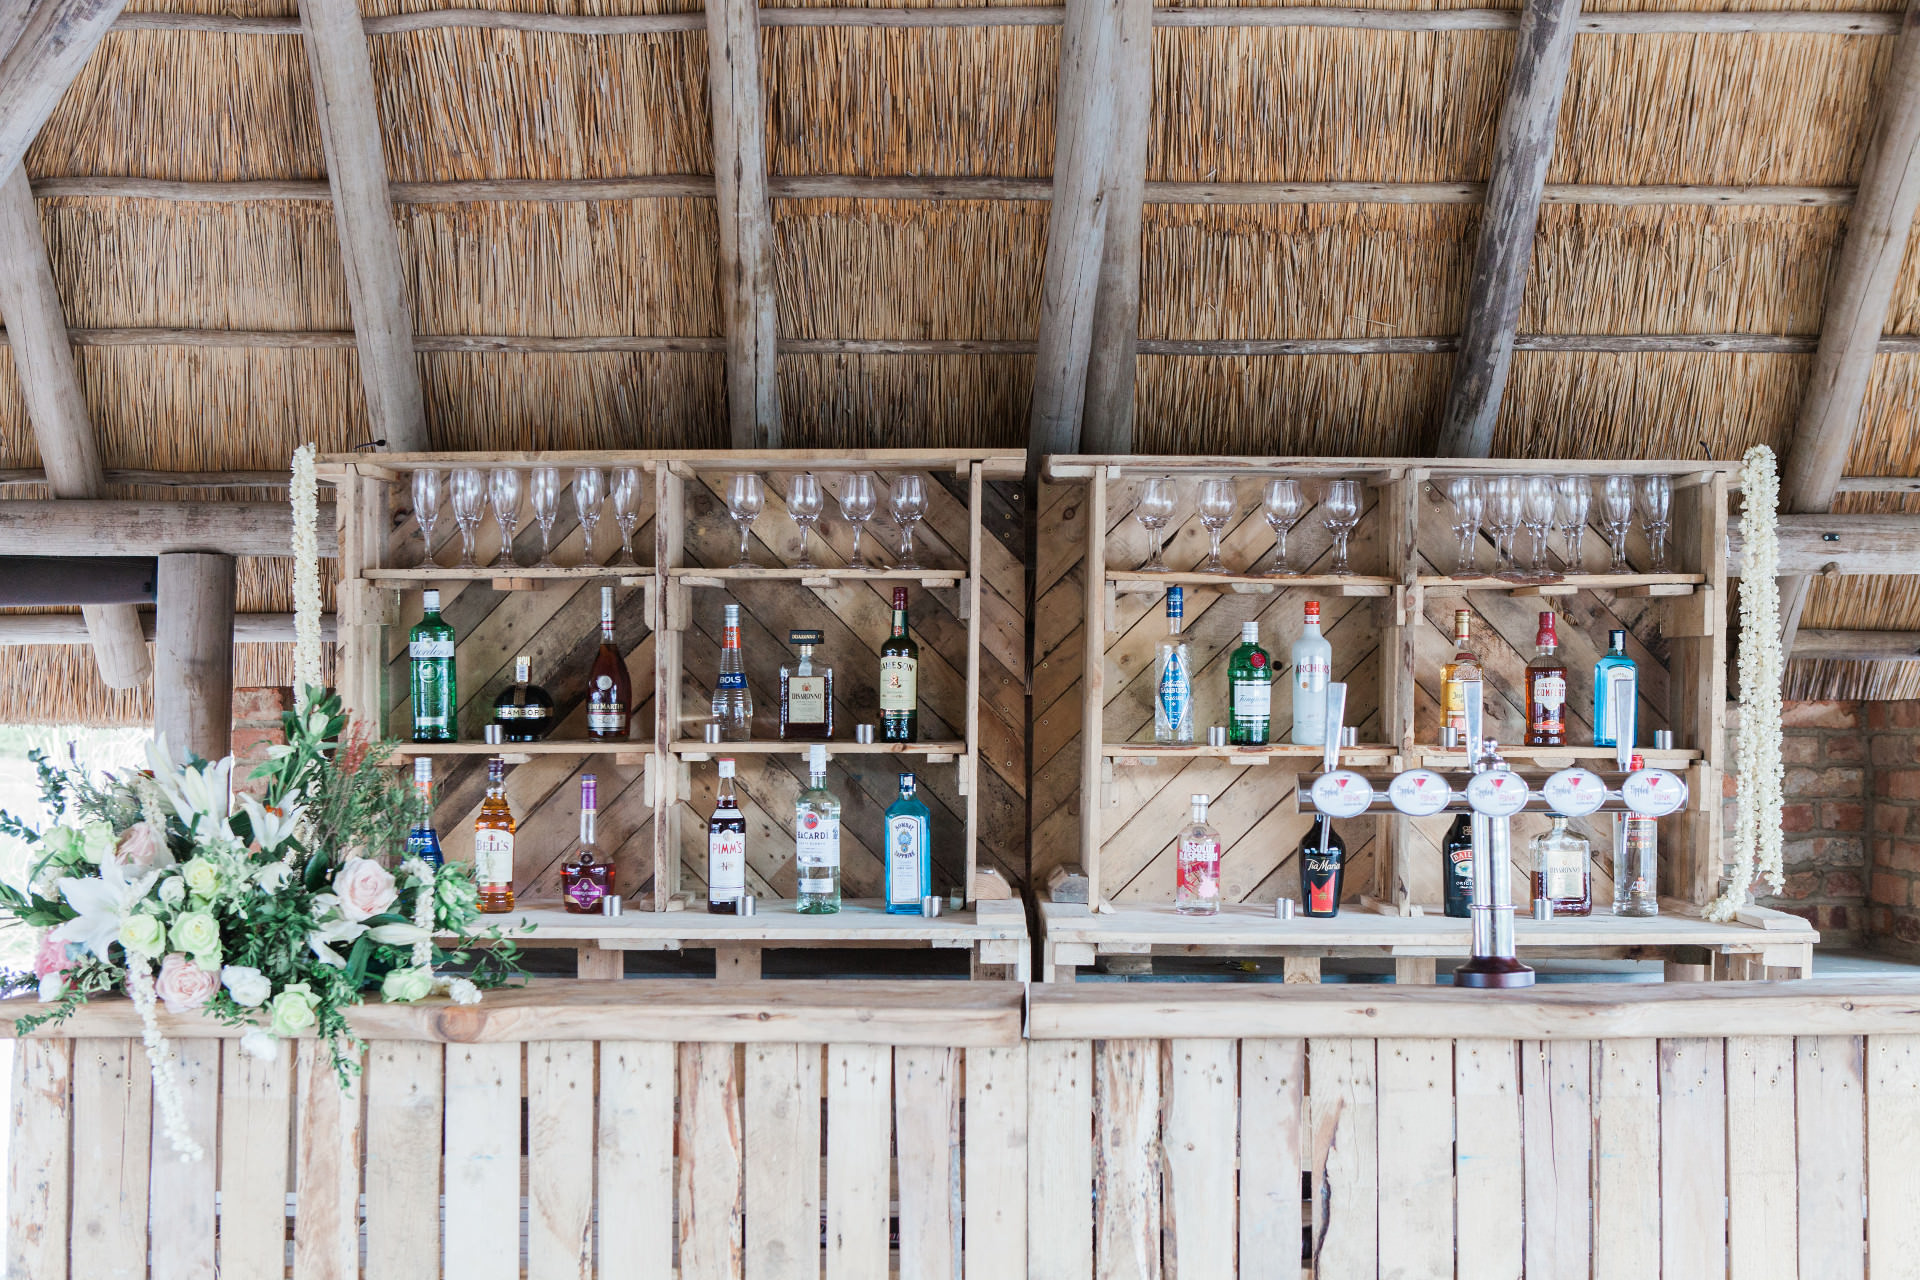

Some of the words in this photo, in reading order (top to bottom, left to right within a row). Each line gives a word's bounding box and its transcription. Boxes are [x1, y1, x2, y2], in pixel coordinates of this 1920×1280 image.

[1295, 663, 1330, 674] ARCHERS
[719, 676, 742, 684] BOLS
[496, 708, 547, 717] CHAMBORD
[797, 831, 830, 840] BACARDI
[476, 839, 510, 851] BELL'S
[712, 841, 743, 854] PIMM'S
[1452, 851, 1473, 862] BAIL
[1317, 859, 1341, 872] Maria
